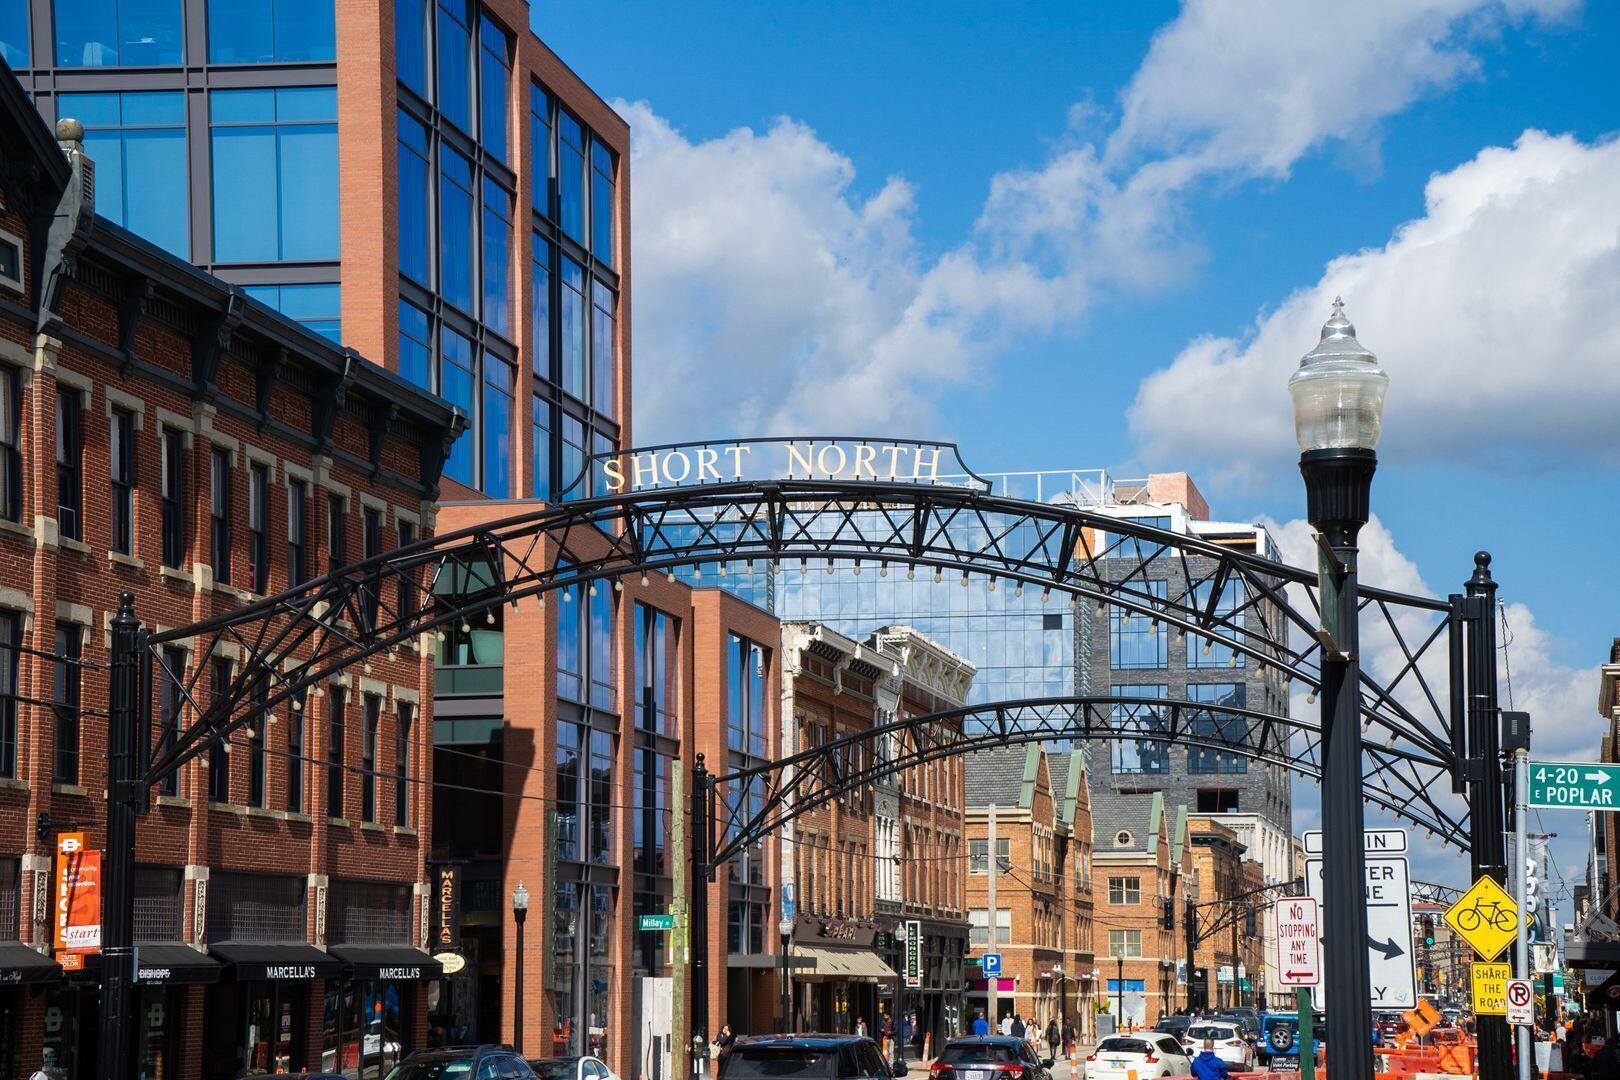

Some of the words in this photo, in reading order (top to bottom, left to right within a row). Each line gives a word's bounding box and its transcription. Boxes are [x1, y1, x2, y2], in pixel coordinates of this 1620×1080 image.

[603, 446, 751, 491] SHORT
[784, 445, 943, 481] NORTH
[1535, 768, 1578, 784] 4-20
[1535, 789, 1540, 798] E
[1546, 787, 1612, 805] POPLAR
[1290, 906, 1303, 920] NO
[642, 919, 663, 929] Millay
[70, 928, 98, 940] start
[832, 926, 858, 941] PEARL
[1280, 924, 1315, 938] STOPPING
[909, 926, 917, 976] LEMONGRASS
[1291, 940, 1306, 951] ANY
[987, 956, 997, 970] P
[1290, 953, 1307, 965] TIME
[266, 966, 315, 979] MARCELLA'S
[379, 967, 420, 979] MARCELLA'S
[1475, 969, 1507, 979] SHARE
[1484, 984, 1501, 994] THE
